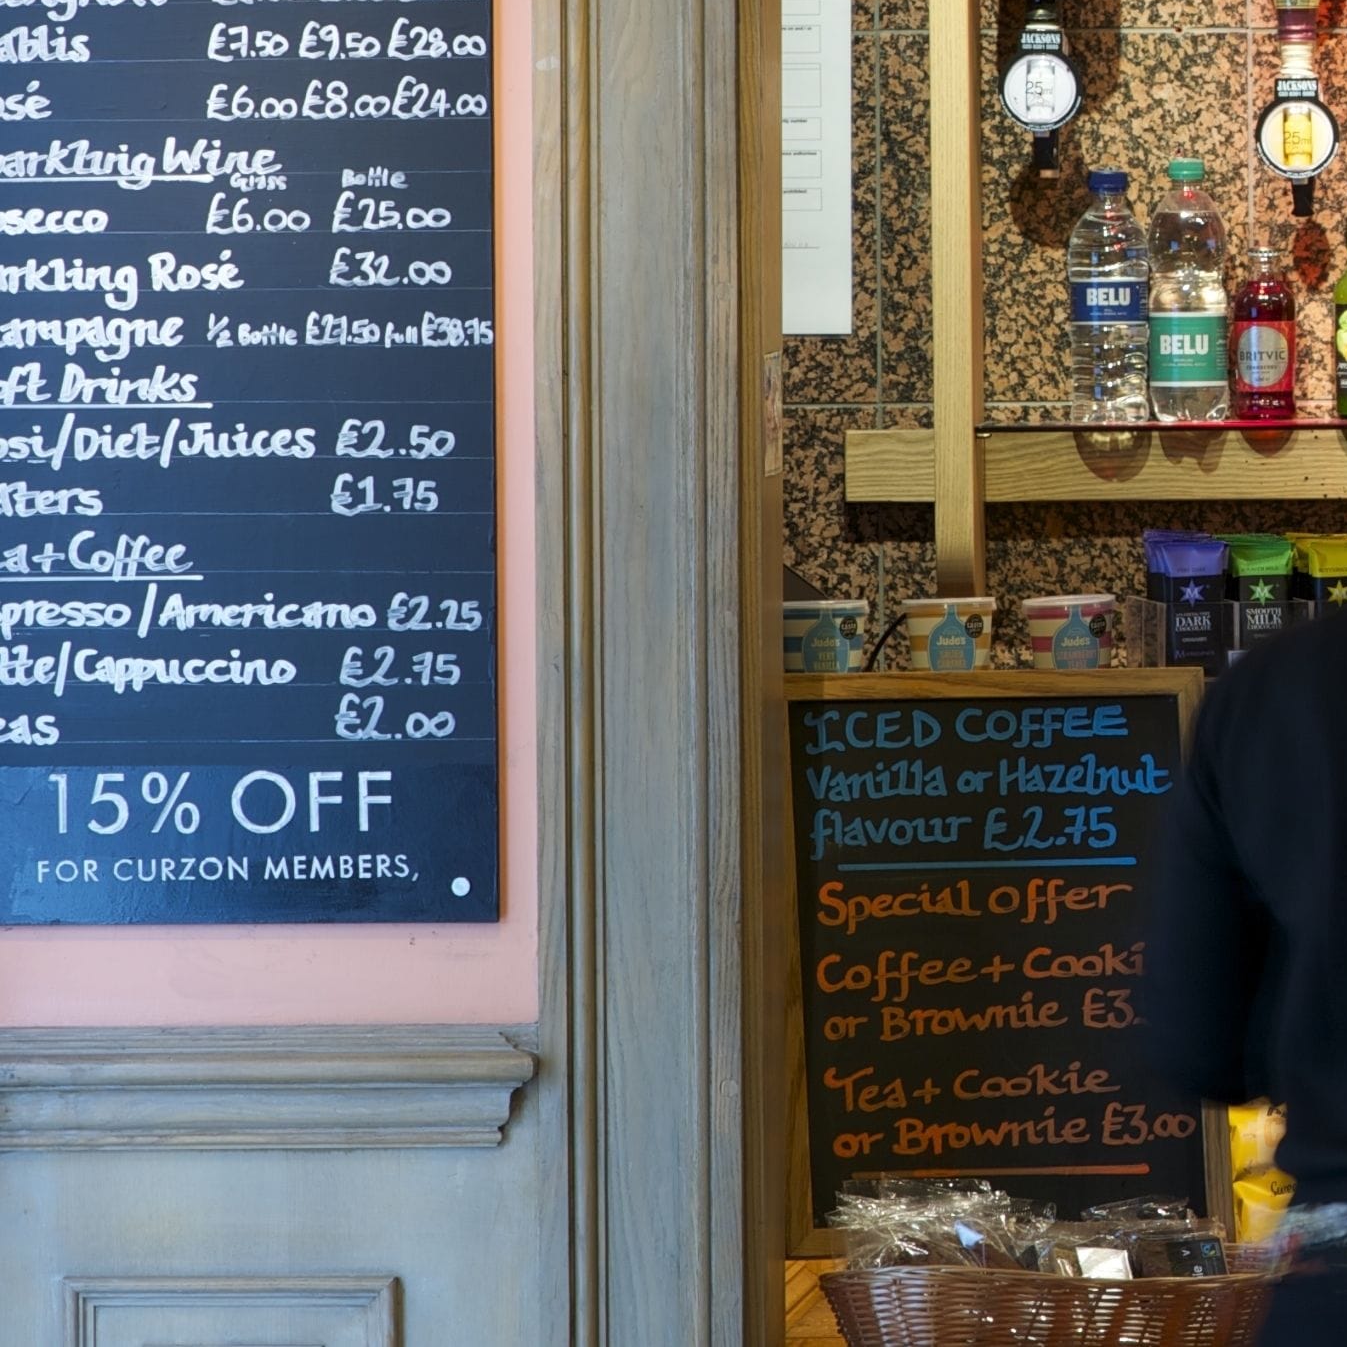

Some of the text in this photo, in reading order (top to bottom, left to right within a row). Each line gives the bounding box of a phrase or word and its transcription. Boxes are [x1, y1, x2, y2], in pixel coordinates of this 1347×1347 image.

[332, 191, 452, 233] £25.00
[148, 247, 452, 291] Rosé £32.00
[1086, 288, 1130, 306] BELU
[1160, 335, 1209, 355] BELU
[1240, 351, 1286, 361] BRITVIC
[58, 364, 198, 404] Drinks
[336, 419, 455, 459] £2.50
[331, 473, 439, 516] £1.75
[339, 646, 461, 686] £2.75
[805, 709, 941, 754] ICED
[806, 753, 1173, 803] Vanilla or Hazelnut
[48, 770, 392, 834] 15% OFF
[810, 806, 1117, 861] flavour £2.75
[37, 860, 99, 883] FOR
[113, 856, 249, 881] CURZON
[816, 880, 981, 935] Special
[816, 951, 978, 1001] Coffee
[824, 1061, 1121, 1113] Tea Cookie
[833, 1102, 1196, 1158] or Brownie £3.00
